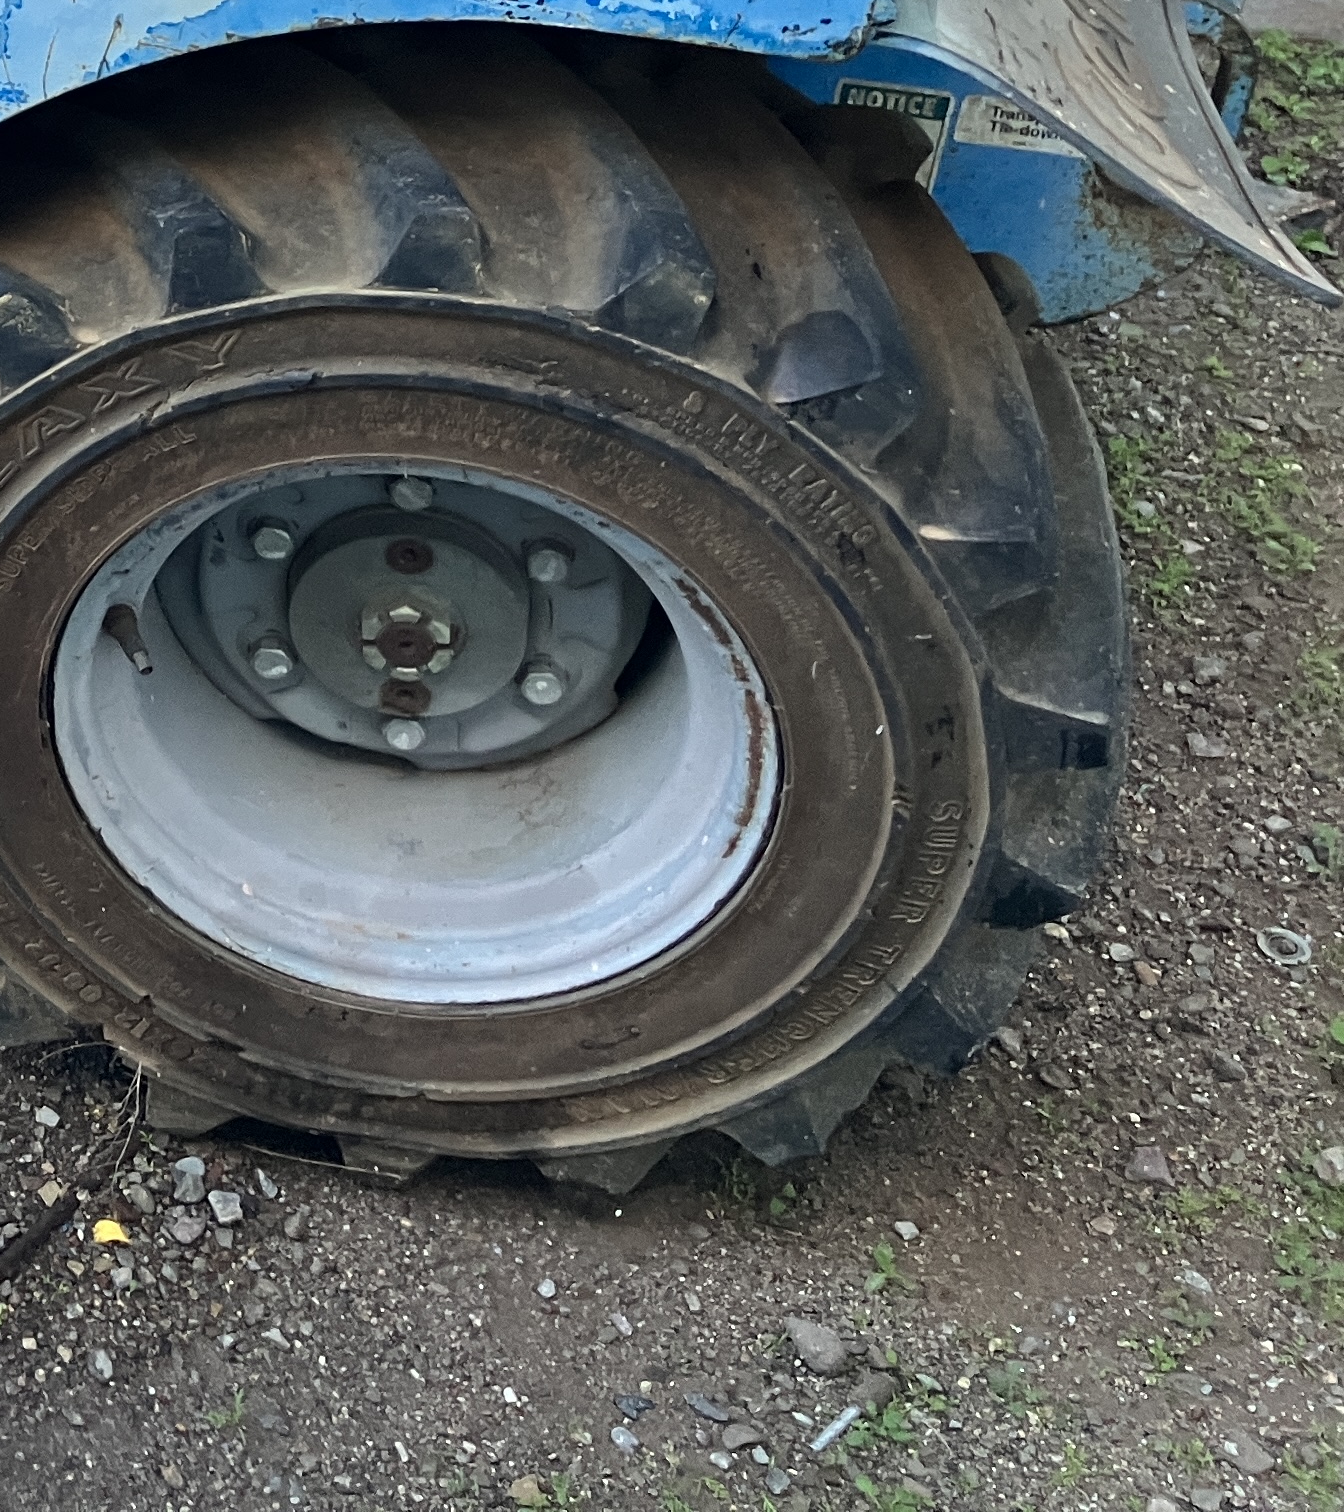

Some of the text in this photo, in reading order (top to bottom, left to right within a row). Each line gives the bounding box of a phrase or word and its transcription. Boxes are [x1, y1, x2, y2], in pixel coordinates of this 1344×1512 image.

[846, 86, 939, 119] NOTICE
[889, 800, 964, 925] SUPER
[705, 941, 906, 1088] TRENCHER
